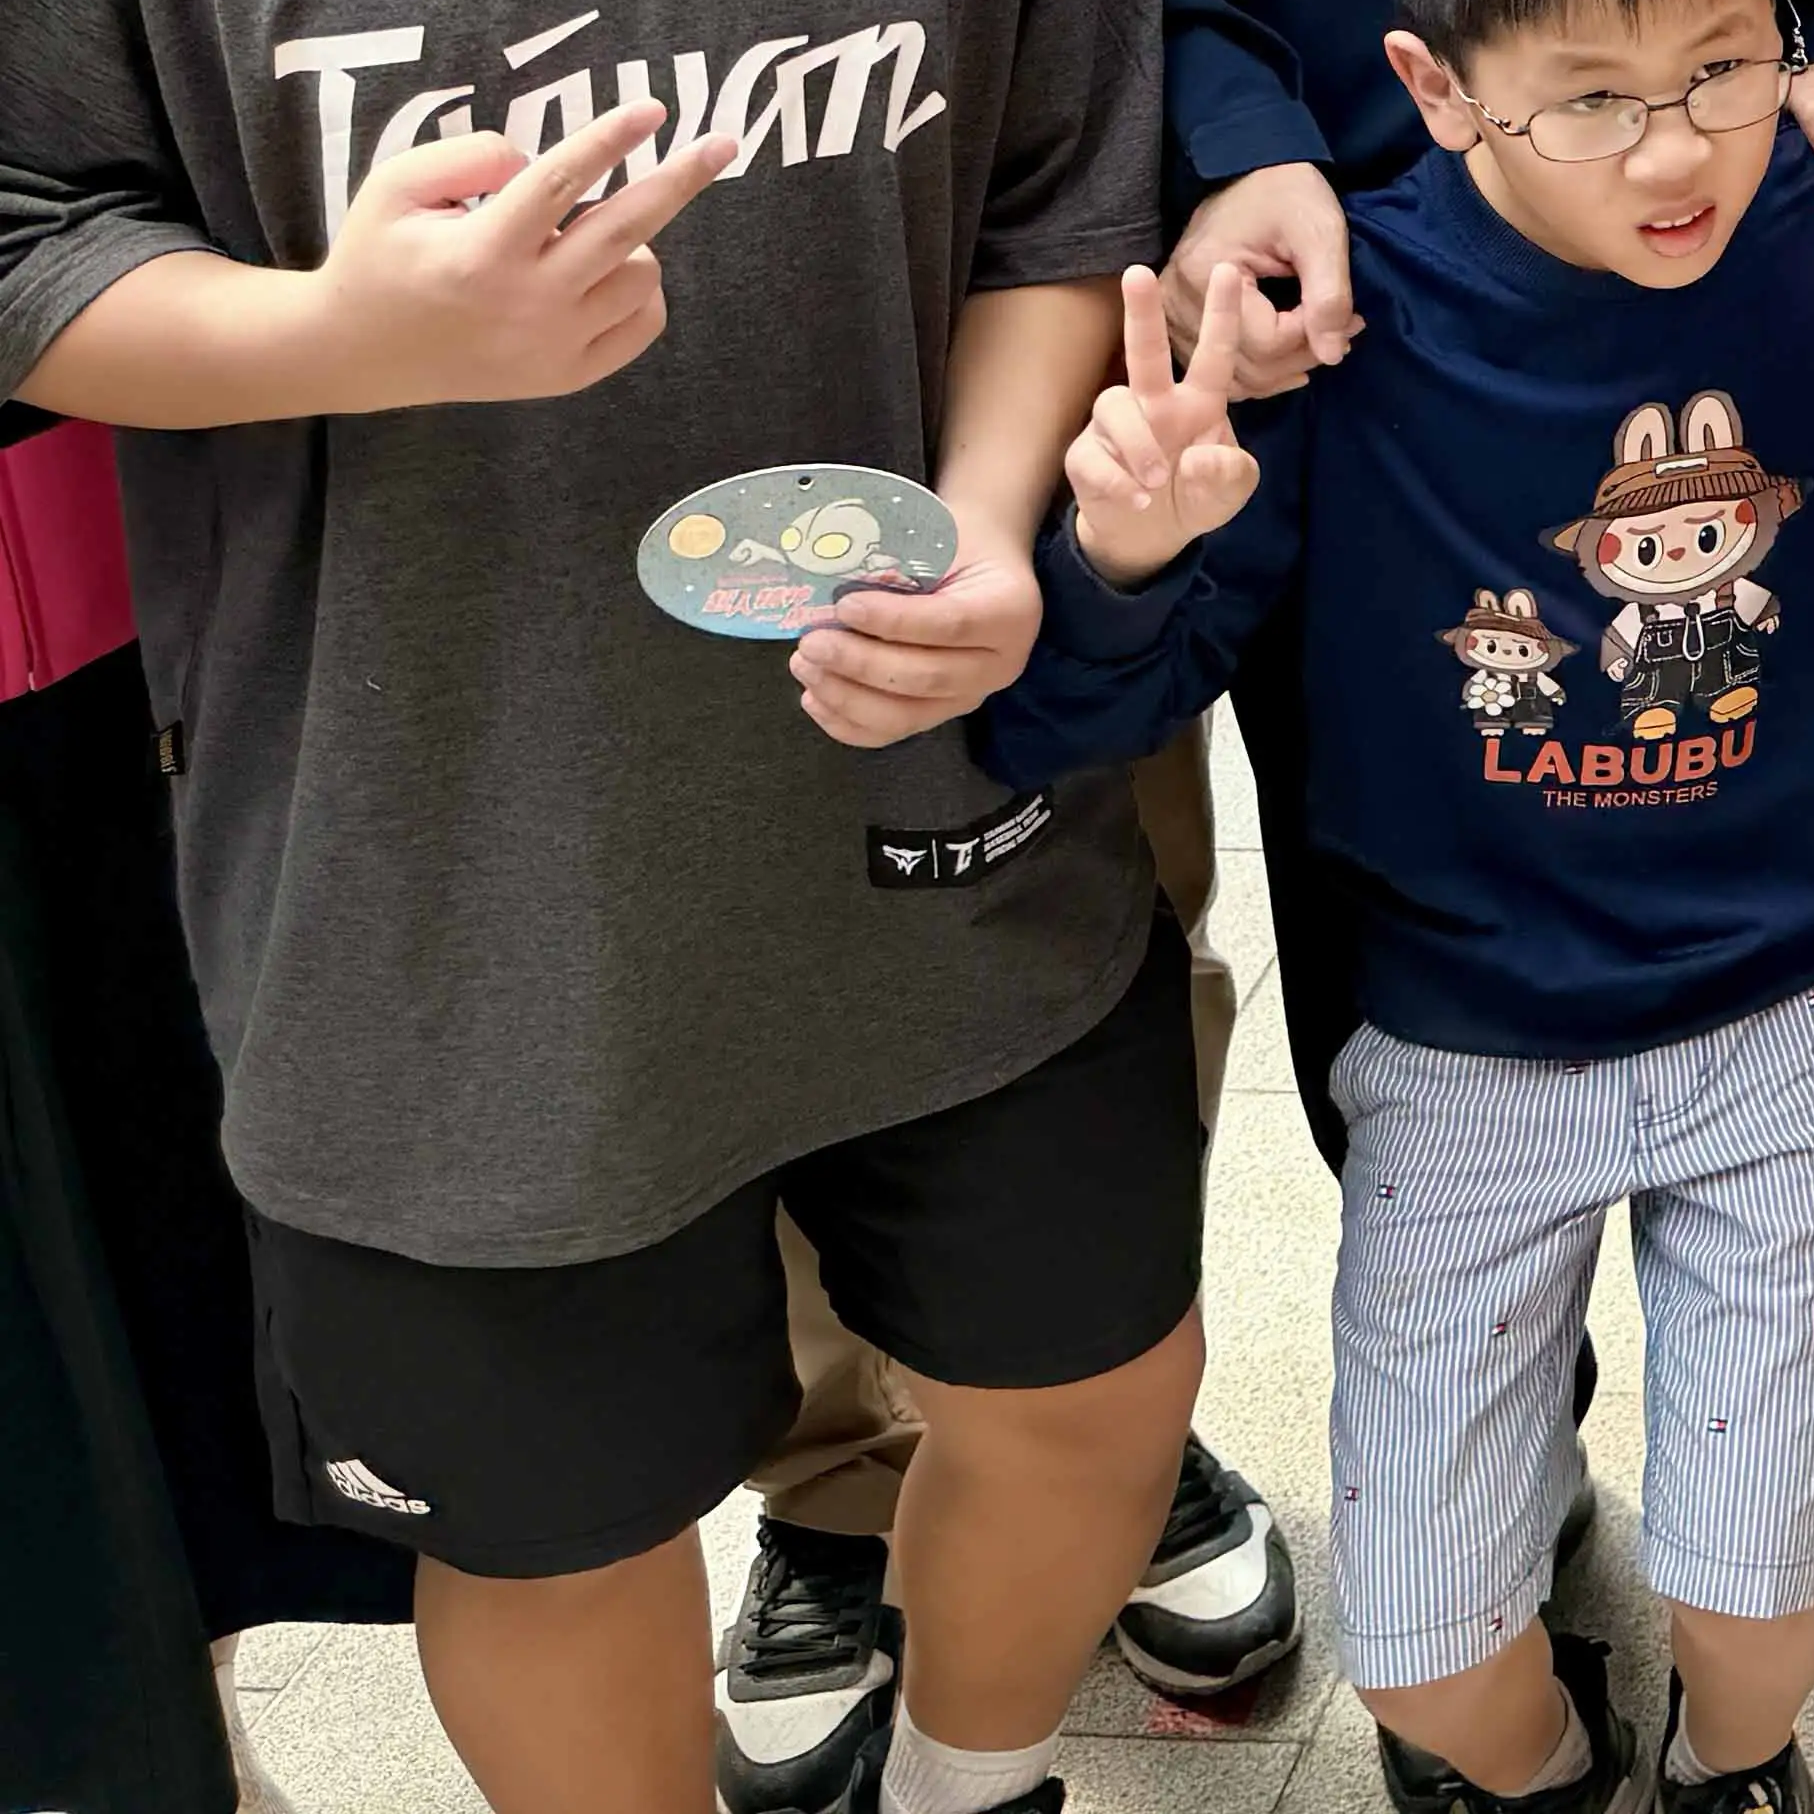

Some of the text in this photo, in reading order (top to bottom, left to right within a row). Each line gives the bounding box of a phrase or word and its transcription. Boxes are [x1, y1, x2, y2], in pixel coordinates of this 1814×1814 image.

[1482, 718, 1758, 788] LABUBU
[1542, 780, 1719, 809] THE MONSTERS
